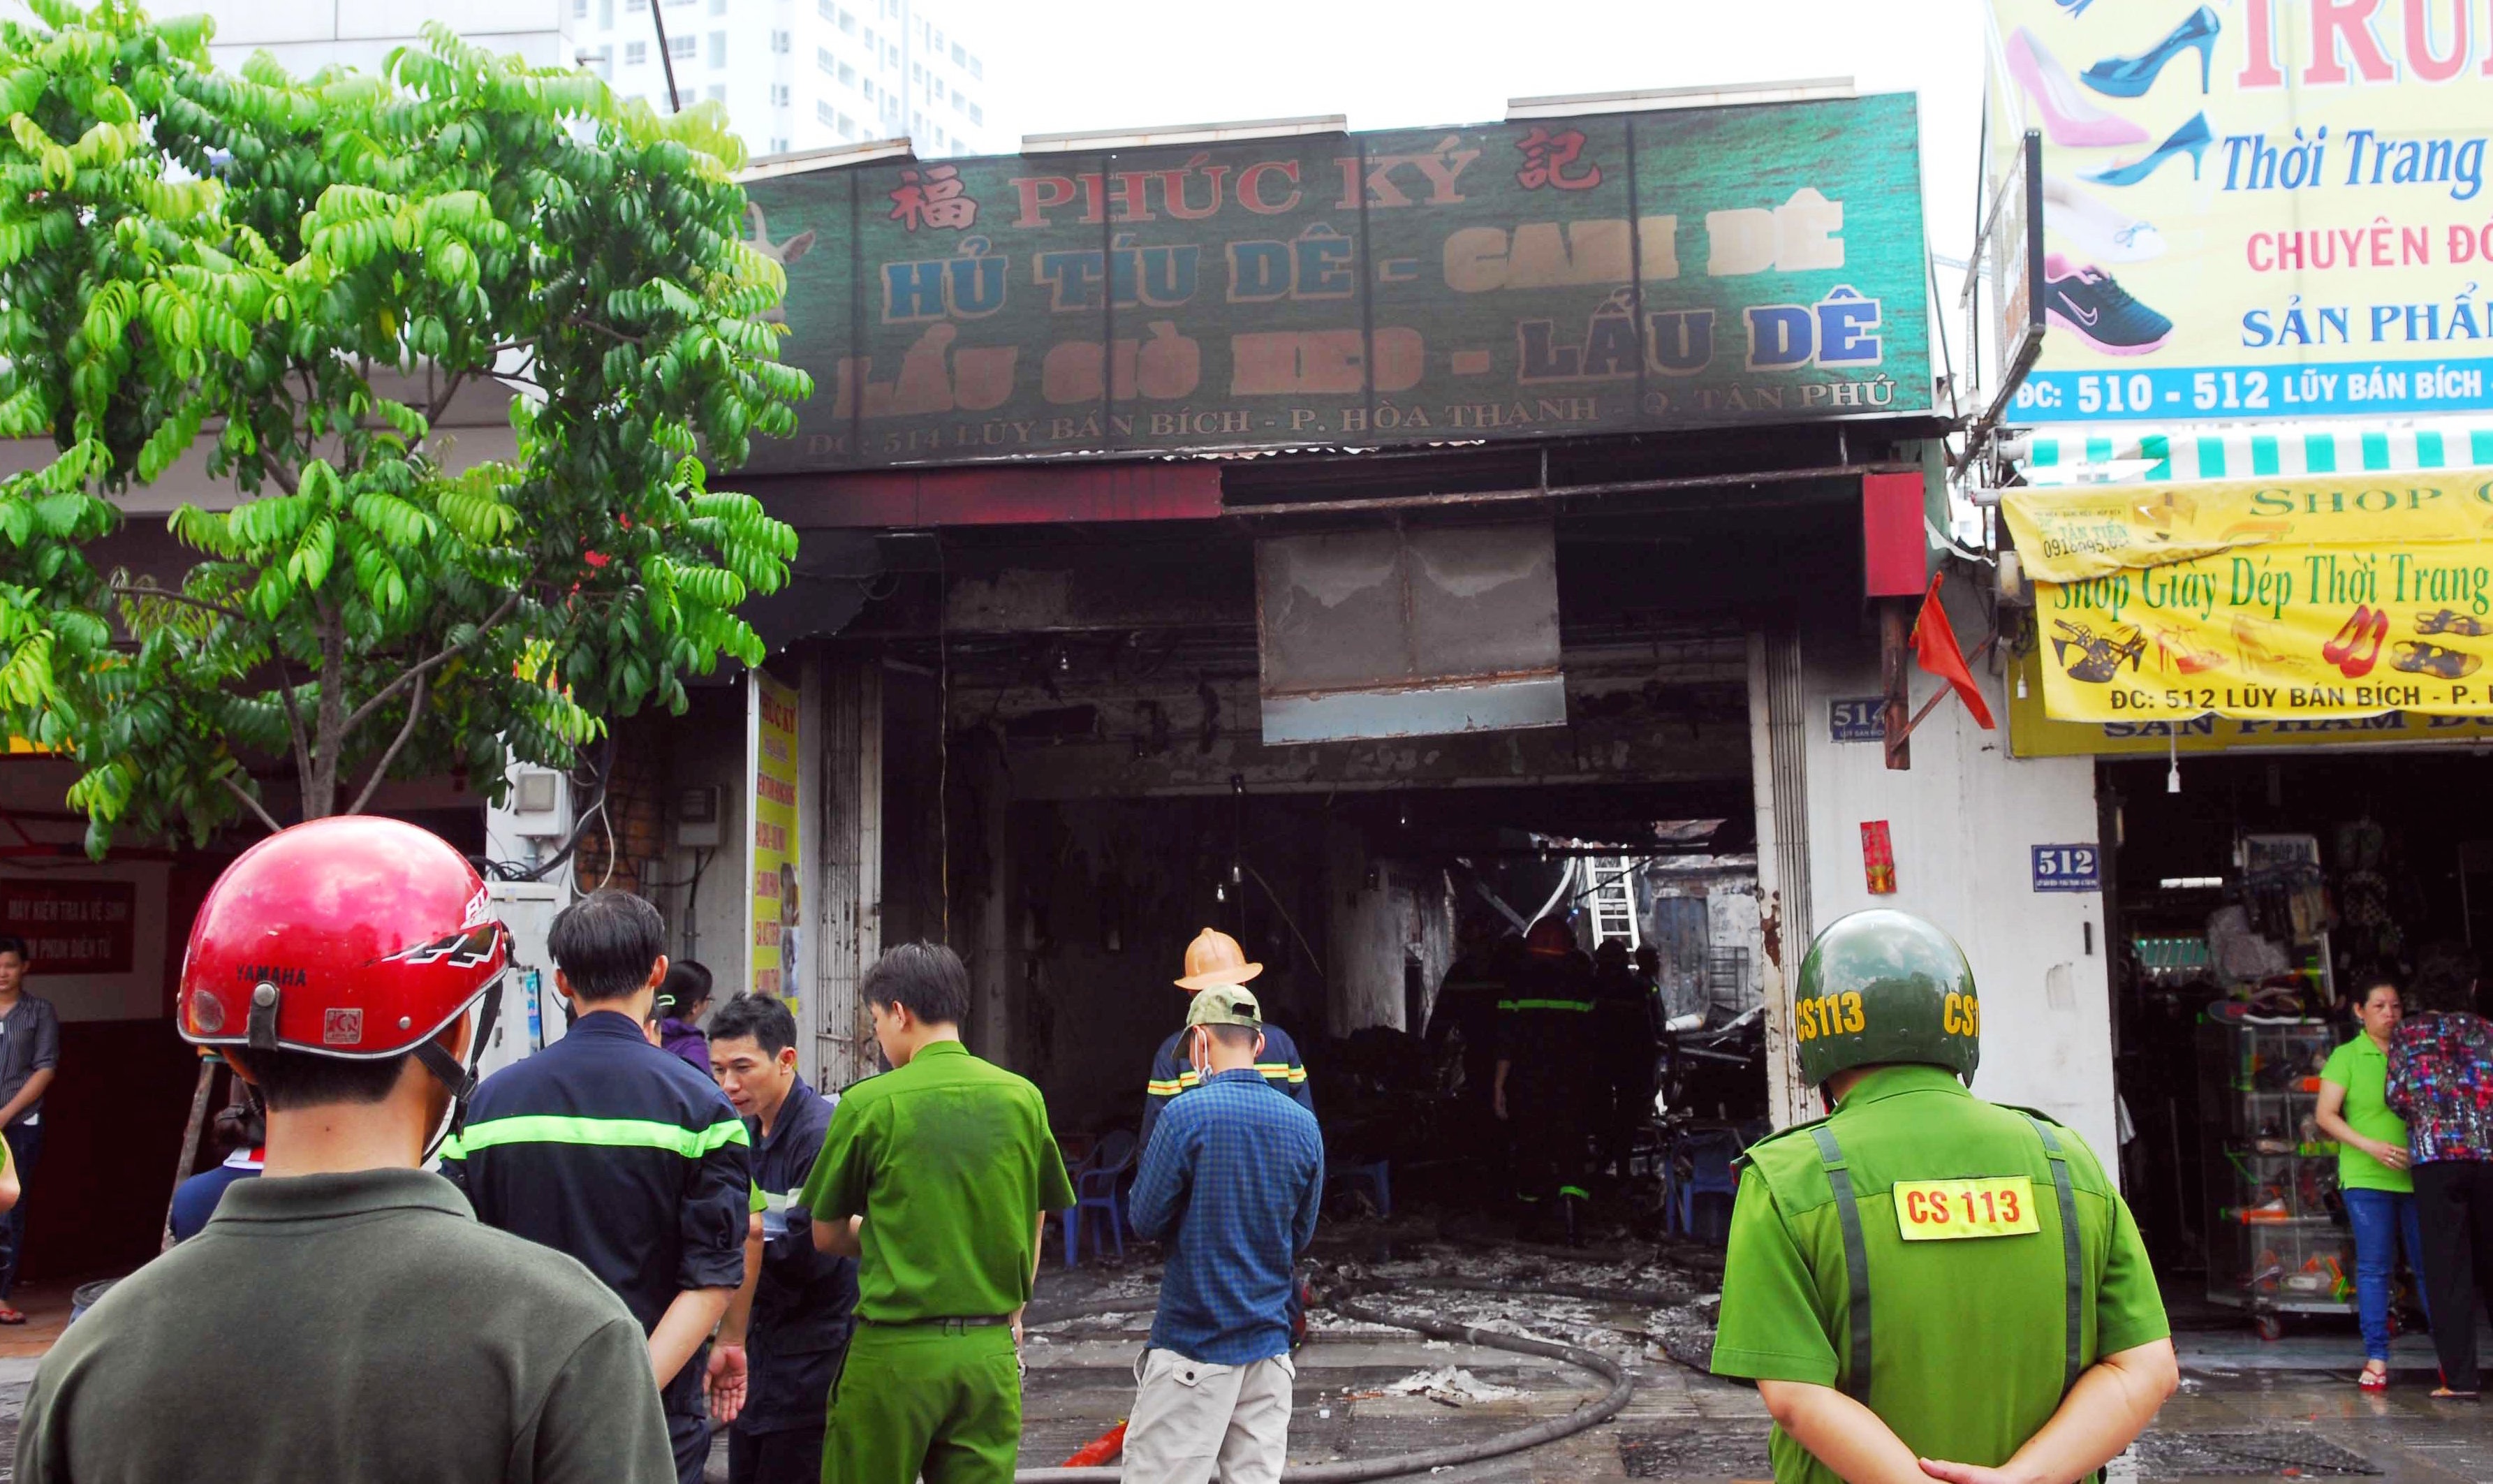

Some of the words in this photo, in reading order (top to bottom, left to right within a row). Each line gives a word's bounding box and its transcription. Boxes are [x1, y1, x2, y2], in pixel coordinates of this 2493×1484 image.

[1009, 152, 1302, 228] PHÚC
[1334, 135, 1482, 210] KÝ
[1515, 127, 1602, 191] 記
[2221, 126, 2328, 191] Thời
[2344, 130, 2489, 201] Trang
[889, 164, 977, 232] 福
[881, 235, 1009, 324] HỦ
[1226, 221, 1354, 303] DÊ
[1706, 187, 1845, 276] DÊ
[2246, 215, 2430, 272] CHUYÊN
[1517, 286, 1715, 385] LẨU
[1744, 284, 1882, 372] DÊ
[2242, 294, 2350, 348] SẢN
[2370, 281, 2493, 342] PHẨ
[883, 427, 941, 454] 514
[955, 418, 1038, 447] LŨY
[1050, 409, 1134, 440] BÁN
[1149, 406, 1253, 436] BÍCH
[1290, 409, 1325, 432] P.
[1341, 399, 1431, 433] HÒA
[1446, 396, 1599, 429] THẠNH
[1695, 381, 1784, 409] TÂN
[1798, 374, 1897, 408] PHÚ
[2015, 381, 2062, 409] ĐC:
[2078, 374, 2153, 413] 510
[2193, 371, 2270, 410] 512
[2284, 369, 2342, 404] LŨY
[2348, 365, 2407, 401] BÁN
[2415, 364, 2483, 399] BÍCH
[2249, 486, 2443, 516] SHOP
[2142, 560, 2216, 621] Giày
[2230, 554, 2292, 619] Dép
[2305, 552, 2378, 605] Thời
[2390, 553, 2490, 615] Trang
[2110, 689, 2154, 710] ĐC:
[2165, 687, 2216, 709] 512
[2228, 682, 2277, 709] LŨY
[2290, 681, 2347, 708] BÁN
[2358, 679, 2420, 707] BÍCH
[2452, 684, 2477, 705] P.
[2038, 849, 2094, 875] 512
[236, 964, 307, 987] YAMAHA
[1795, 990, 1865, 1042] CS113
[1907, 1191, 1950, 1224] CS
[1962, 1189, 2021, 1224] 113
